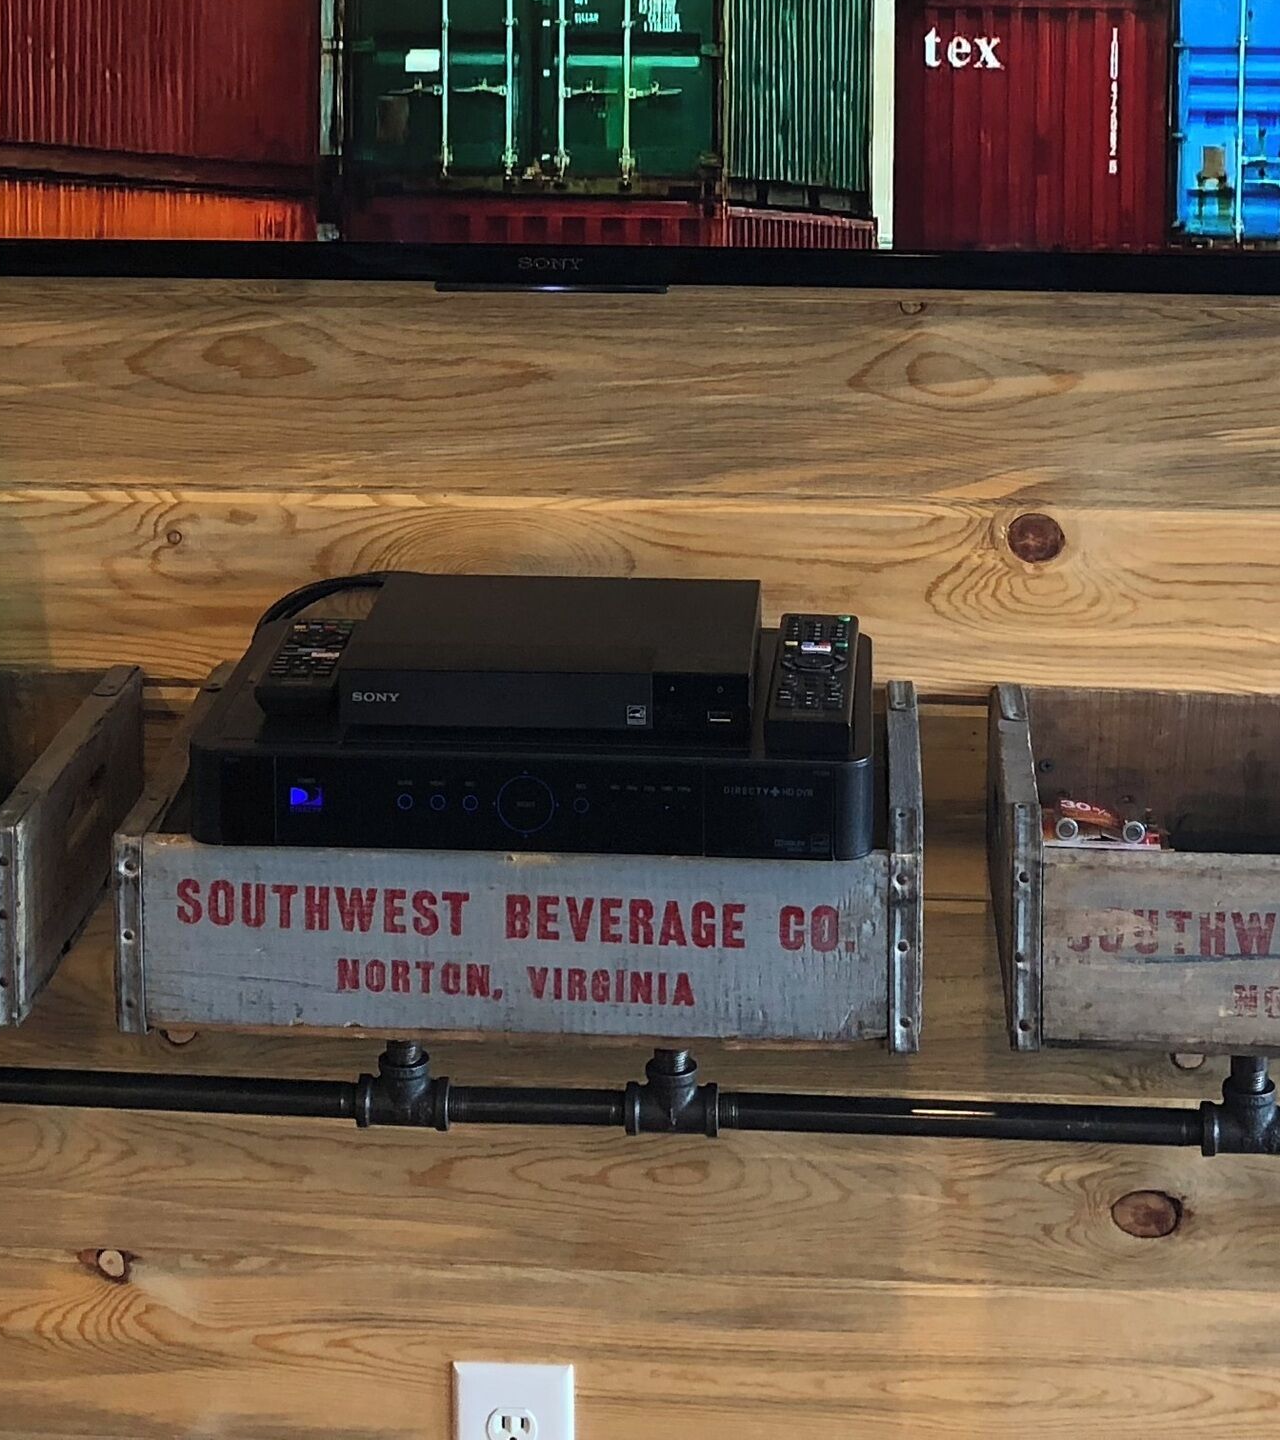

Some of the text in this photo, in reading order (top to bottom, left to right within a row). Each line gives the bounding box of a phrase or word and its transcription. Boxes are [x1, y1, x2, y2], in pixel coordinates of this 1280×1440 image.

[924, 26, 1002, 69] tex
[351, 690, 400, 704] SONY
[175, 877, 857, 954] SOUTHWEST BEVERAGE CO.
[335, 958, 697, 1007] NORTON, VIRGINIA
